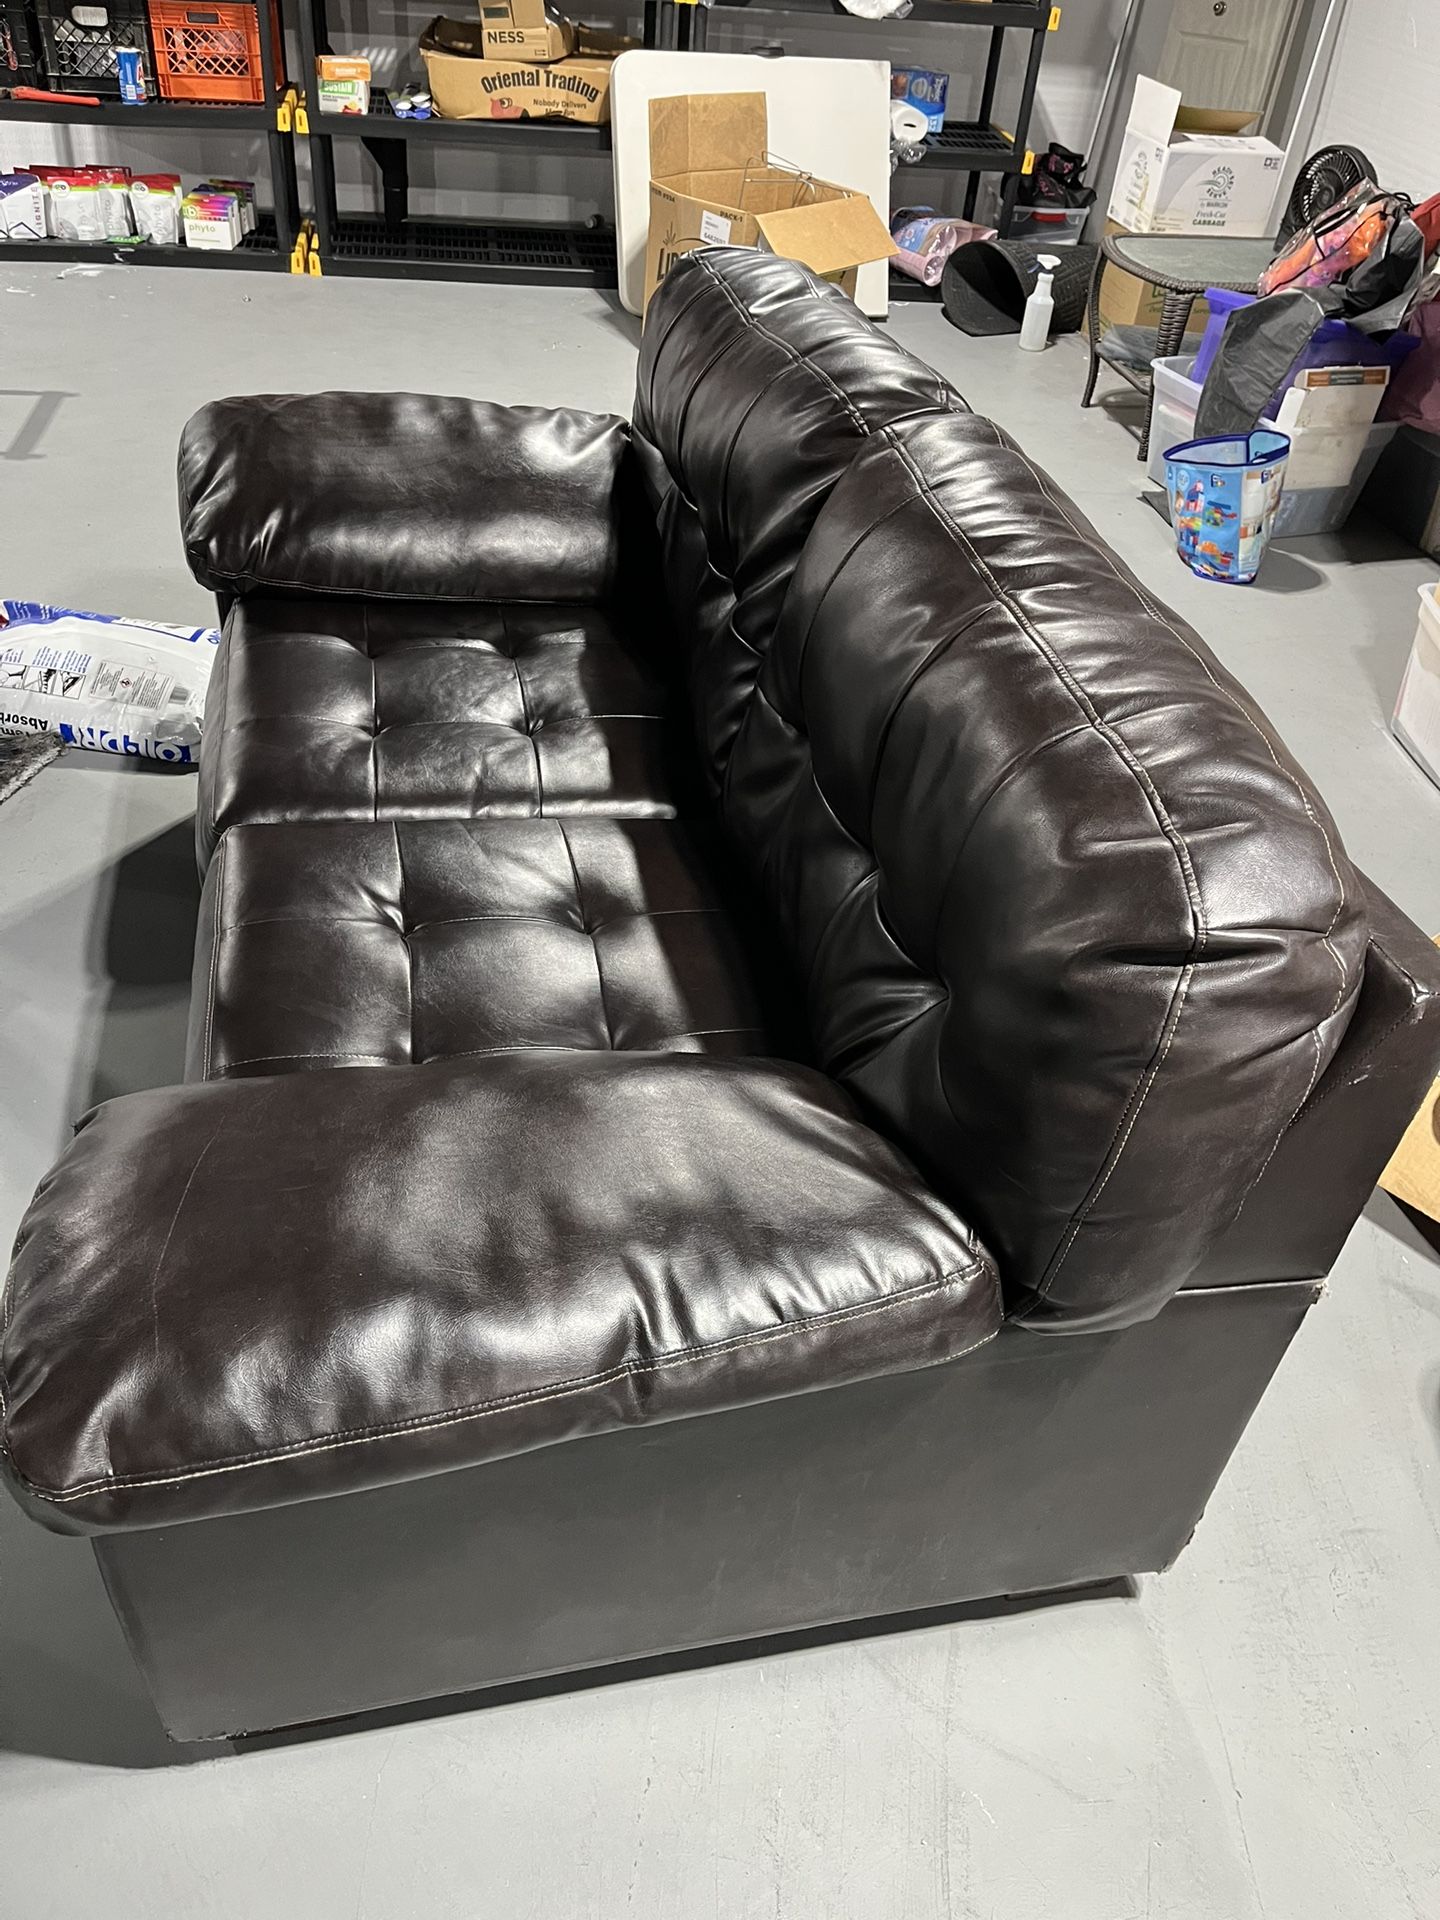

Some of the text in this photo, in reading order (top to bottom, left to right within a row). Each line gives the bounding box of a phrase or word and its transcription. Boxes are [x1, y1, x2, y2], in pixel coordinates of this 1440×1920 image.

[487, 31, 525, 44] NESS
[481, 69, 600, 103] Oriental Trading
[533, 98, 587, 110] Nobody Delivers
[188, 223, 217, 233] phyto
[1192, 218, 1226, 227] CABBAGE
